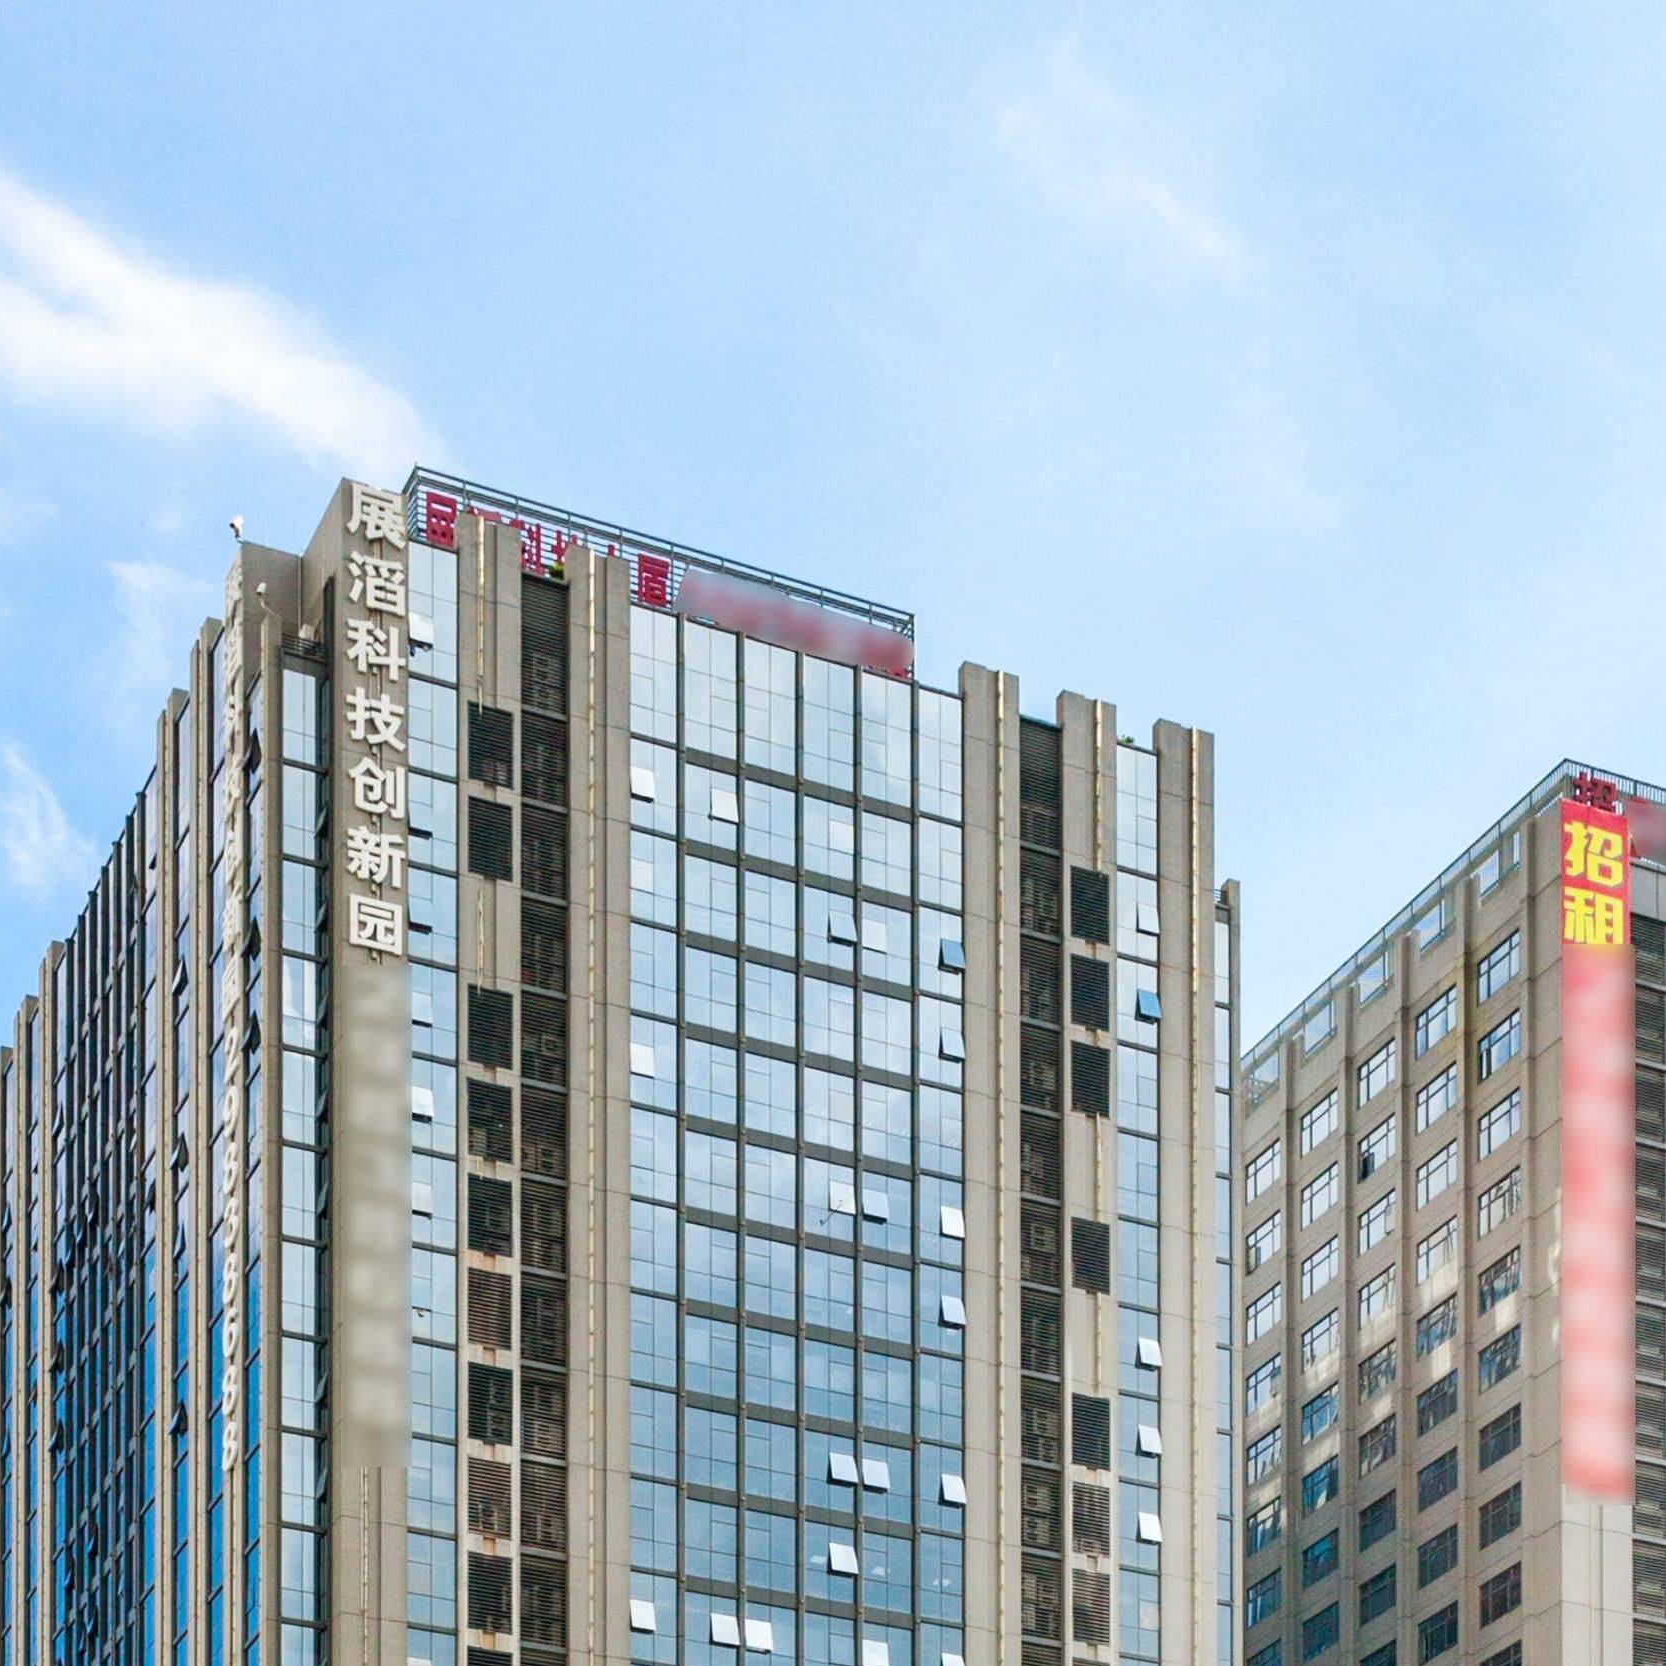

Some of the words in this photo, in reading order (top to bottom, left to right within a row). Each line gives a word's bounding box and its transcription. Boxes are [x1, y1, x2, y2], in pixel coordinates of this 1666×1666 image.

[346, 483, 406, 956] 展滔科技创新园
[1563, 821, 1624, 944] 招租
